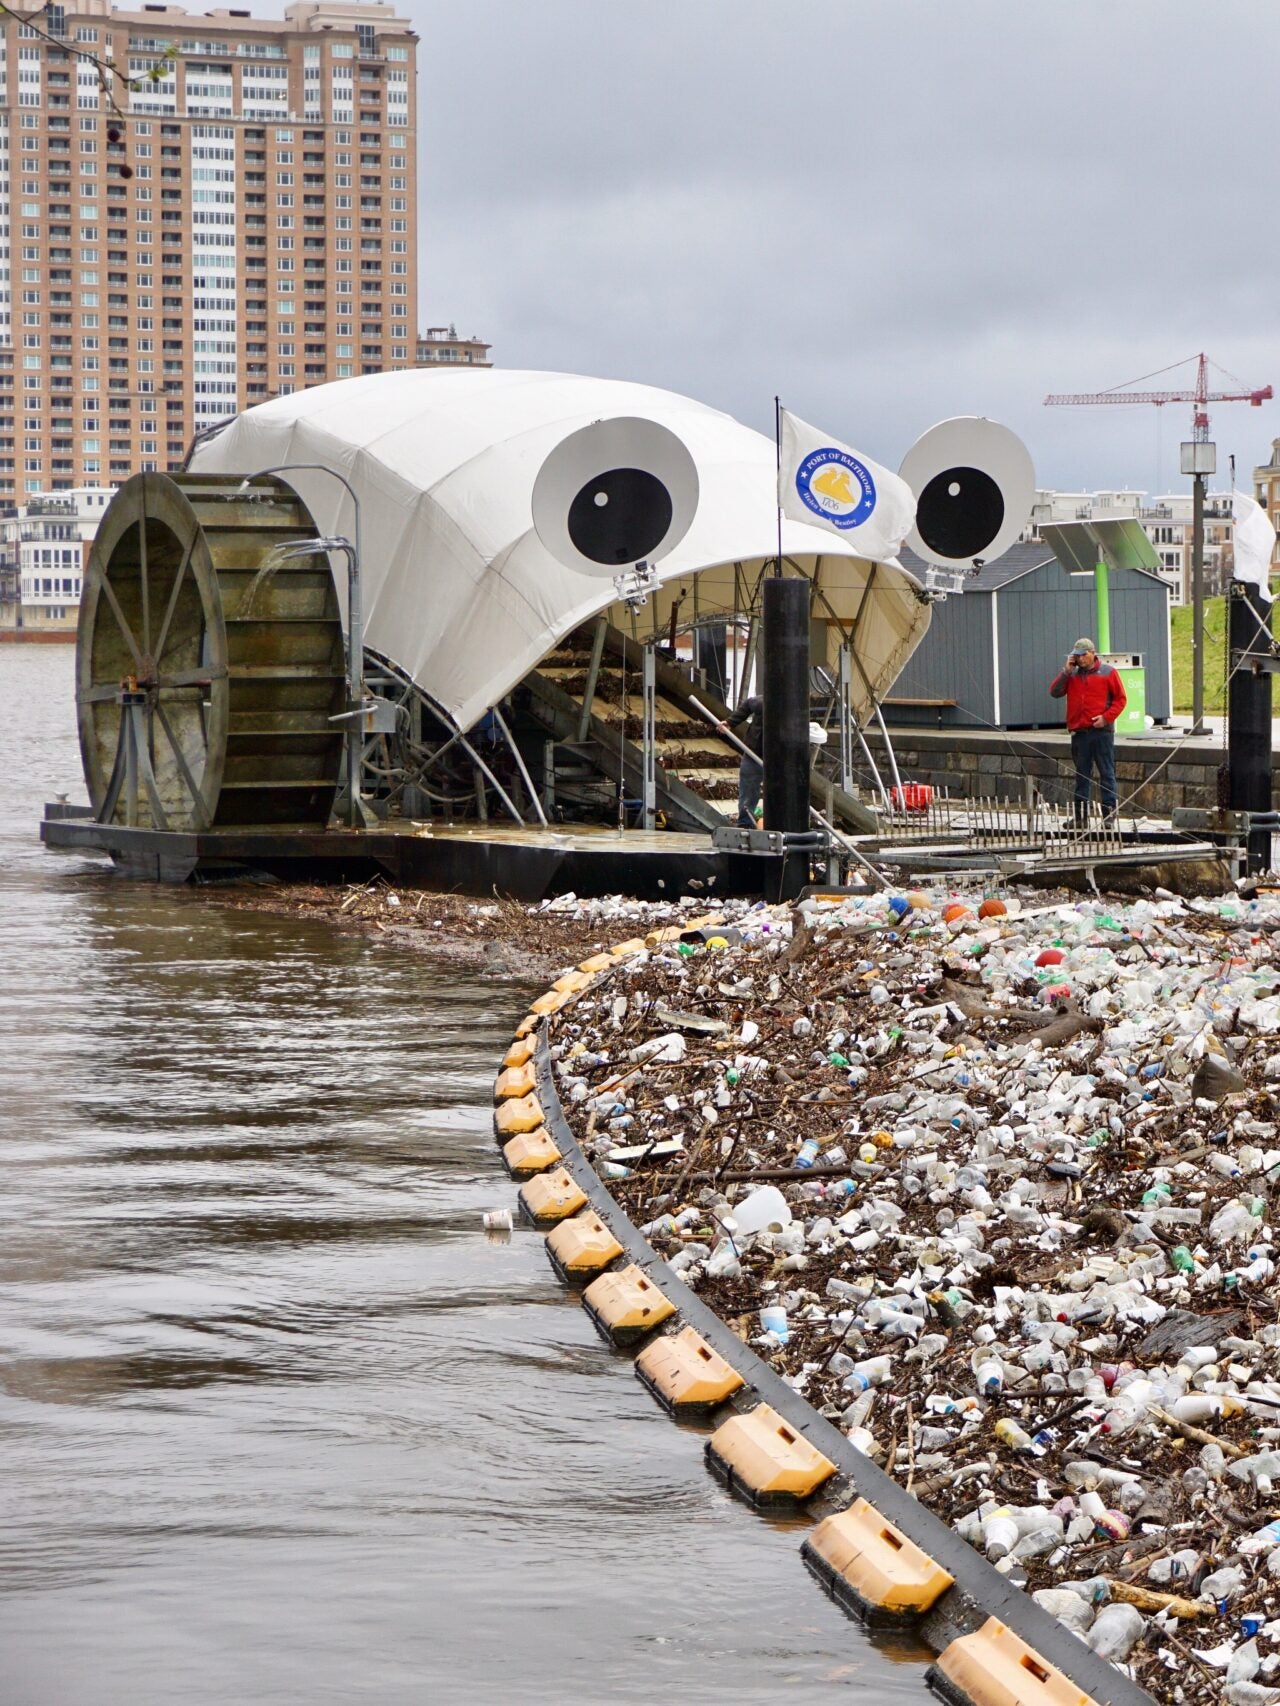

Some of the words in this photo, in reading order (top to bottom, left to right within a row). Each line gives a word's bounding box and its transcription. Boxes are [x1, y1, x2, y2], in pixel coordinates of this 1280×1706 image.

[806, 453, 827, 470] PORT
[828, 452, 840, 460] OF
[841, 455, 872, 496] BALTIMORE
[803, 492, 818, 510] Helen
[822, 497, 840, 510] 1706
[834, 518, 857, 526] Bentley
